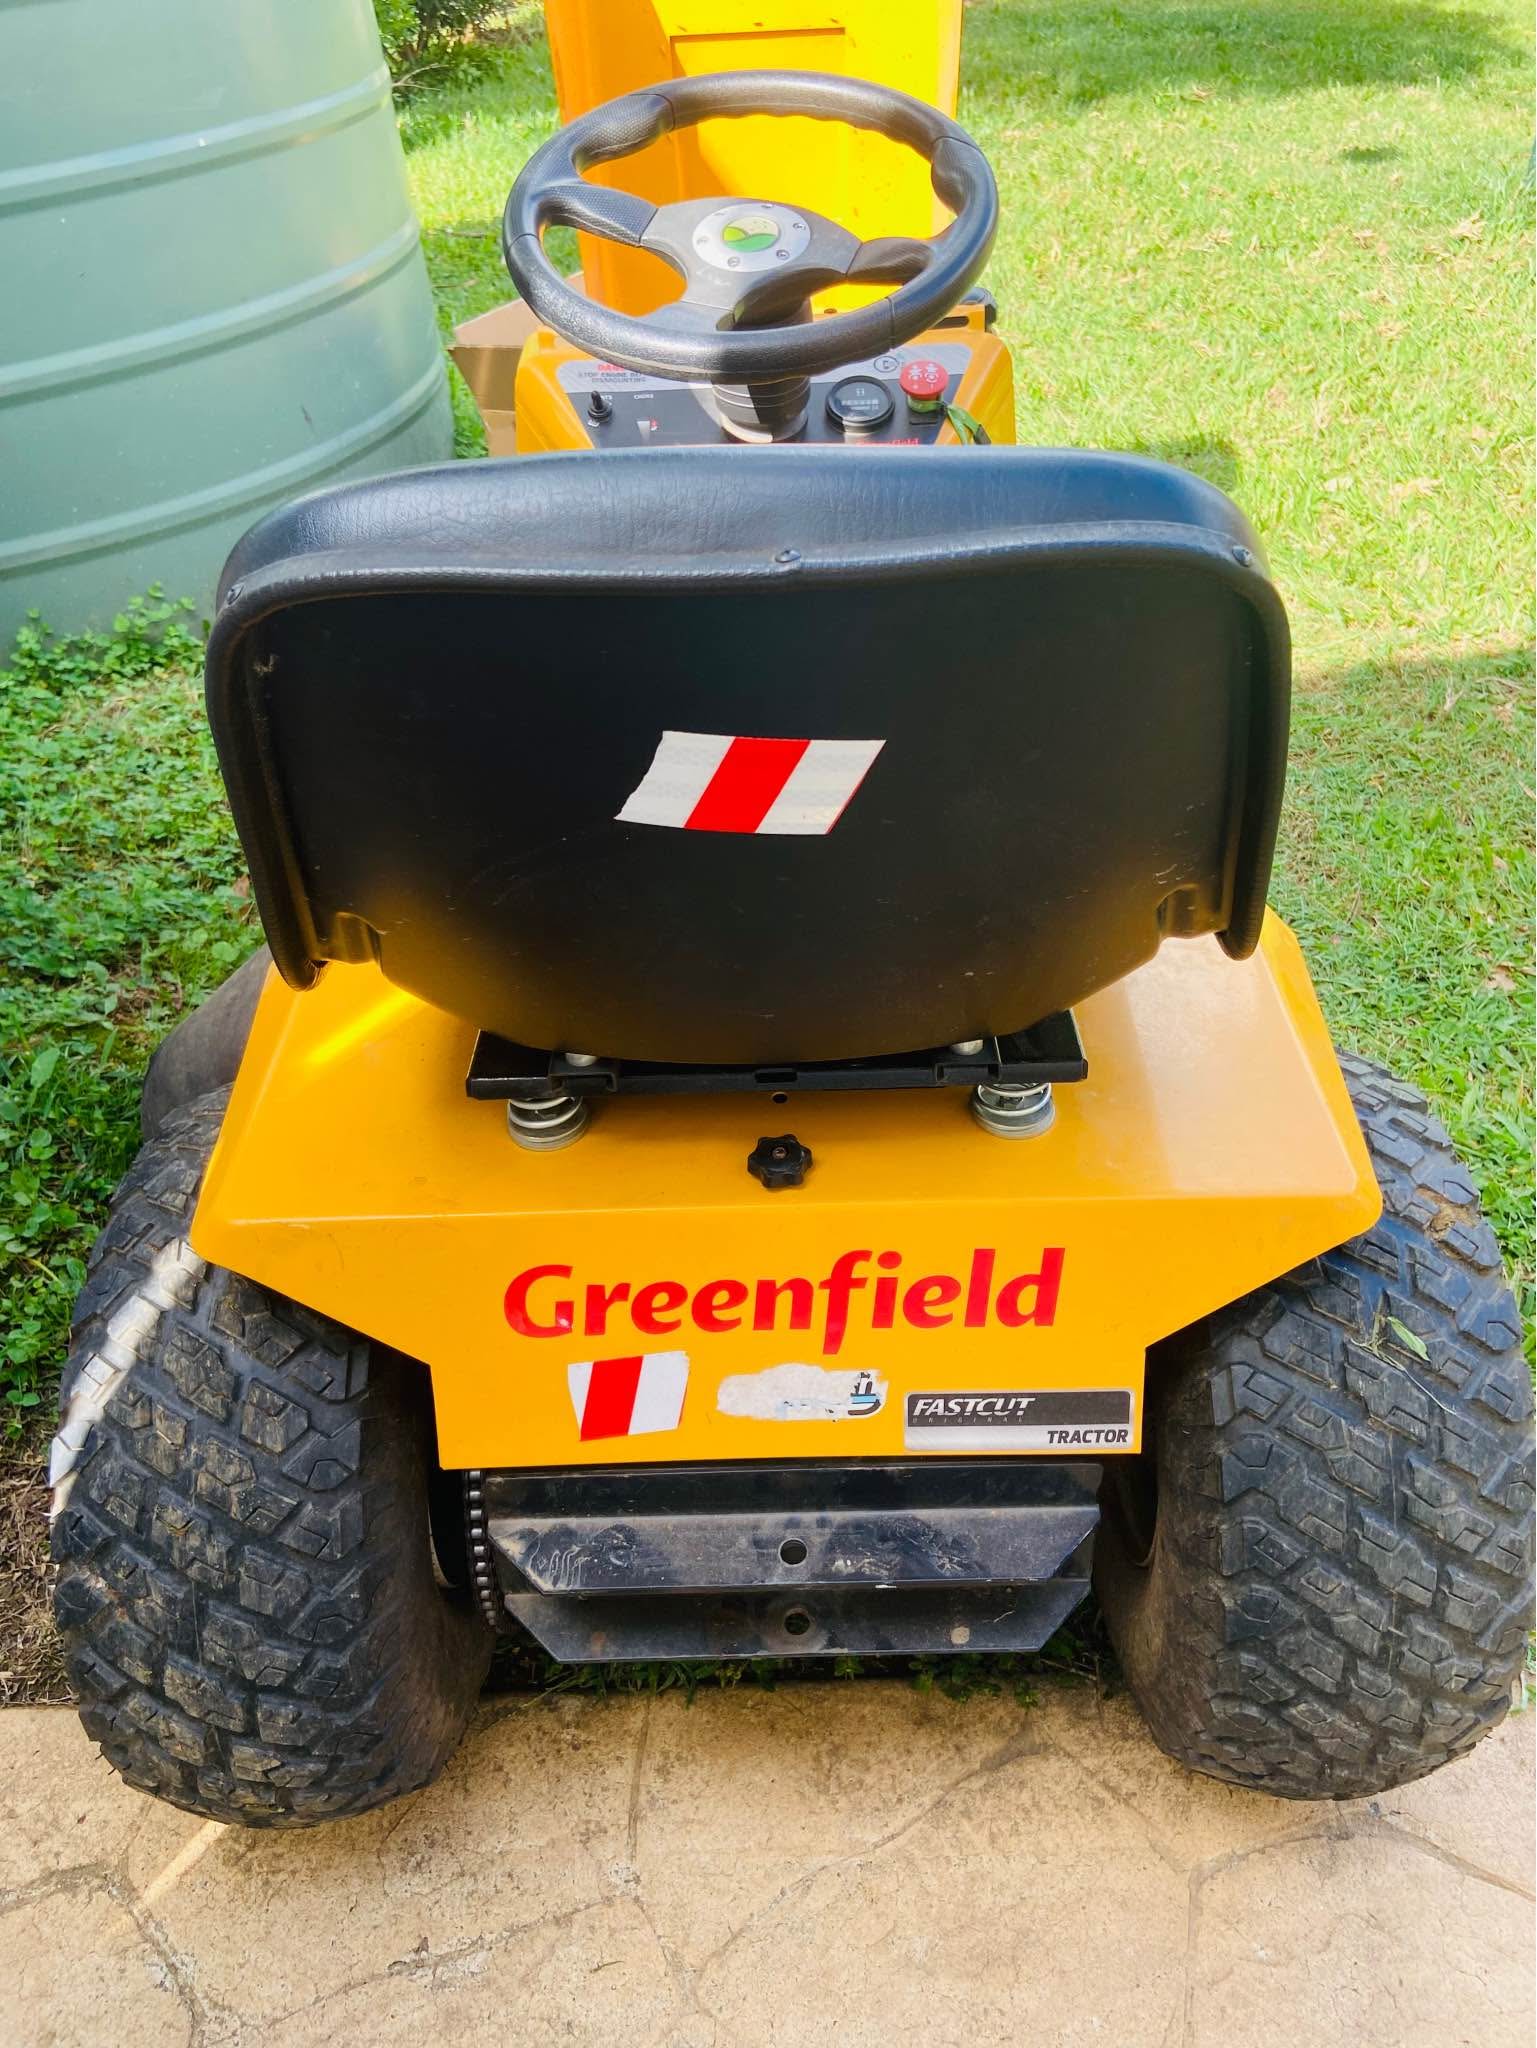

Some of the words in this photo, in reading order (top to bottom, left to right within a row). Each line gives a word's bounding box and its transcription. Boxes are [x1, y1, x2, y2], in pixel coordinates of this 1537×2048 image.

[503, 1247, 1066, 1355] Greenfield
[912, 1397, 1036, 1416] FASTCUT
[1047, 1429, 1129, 1444] TRACTOR
